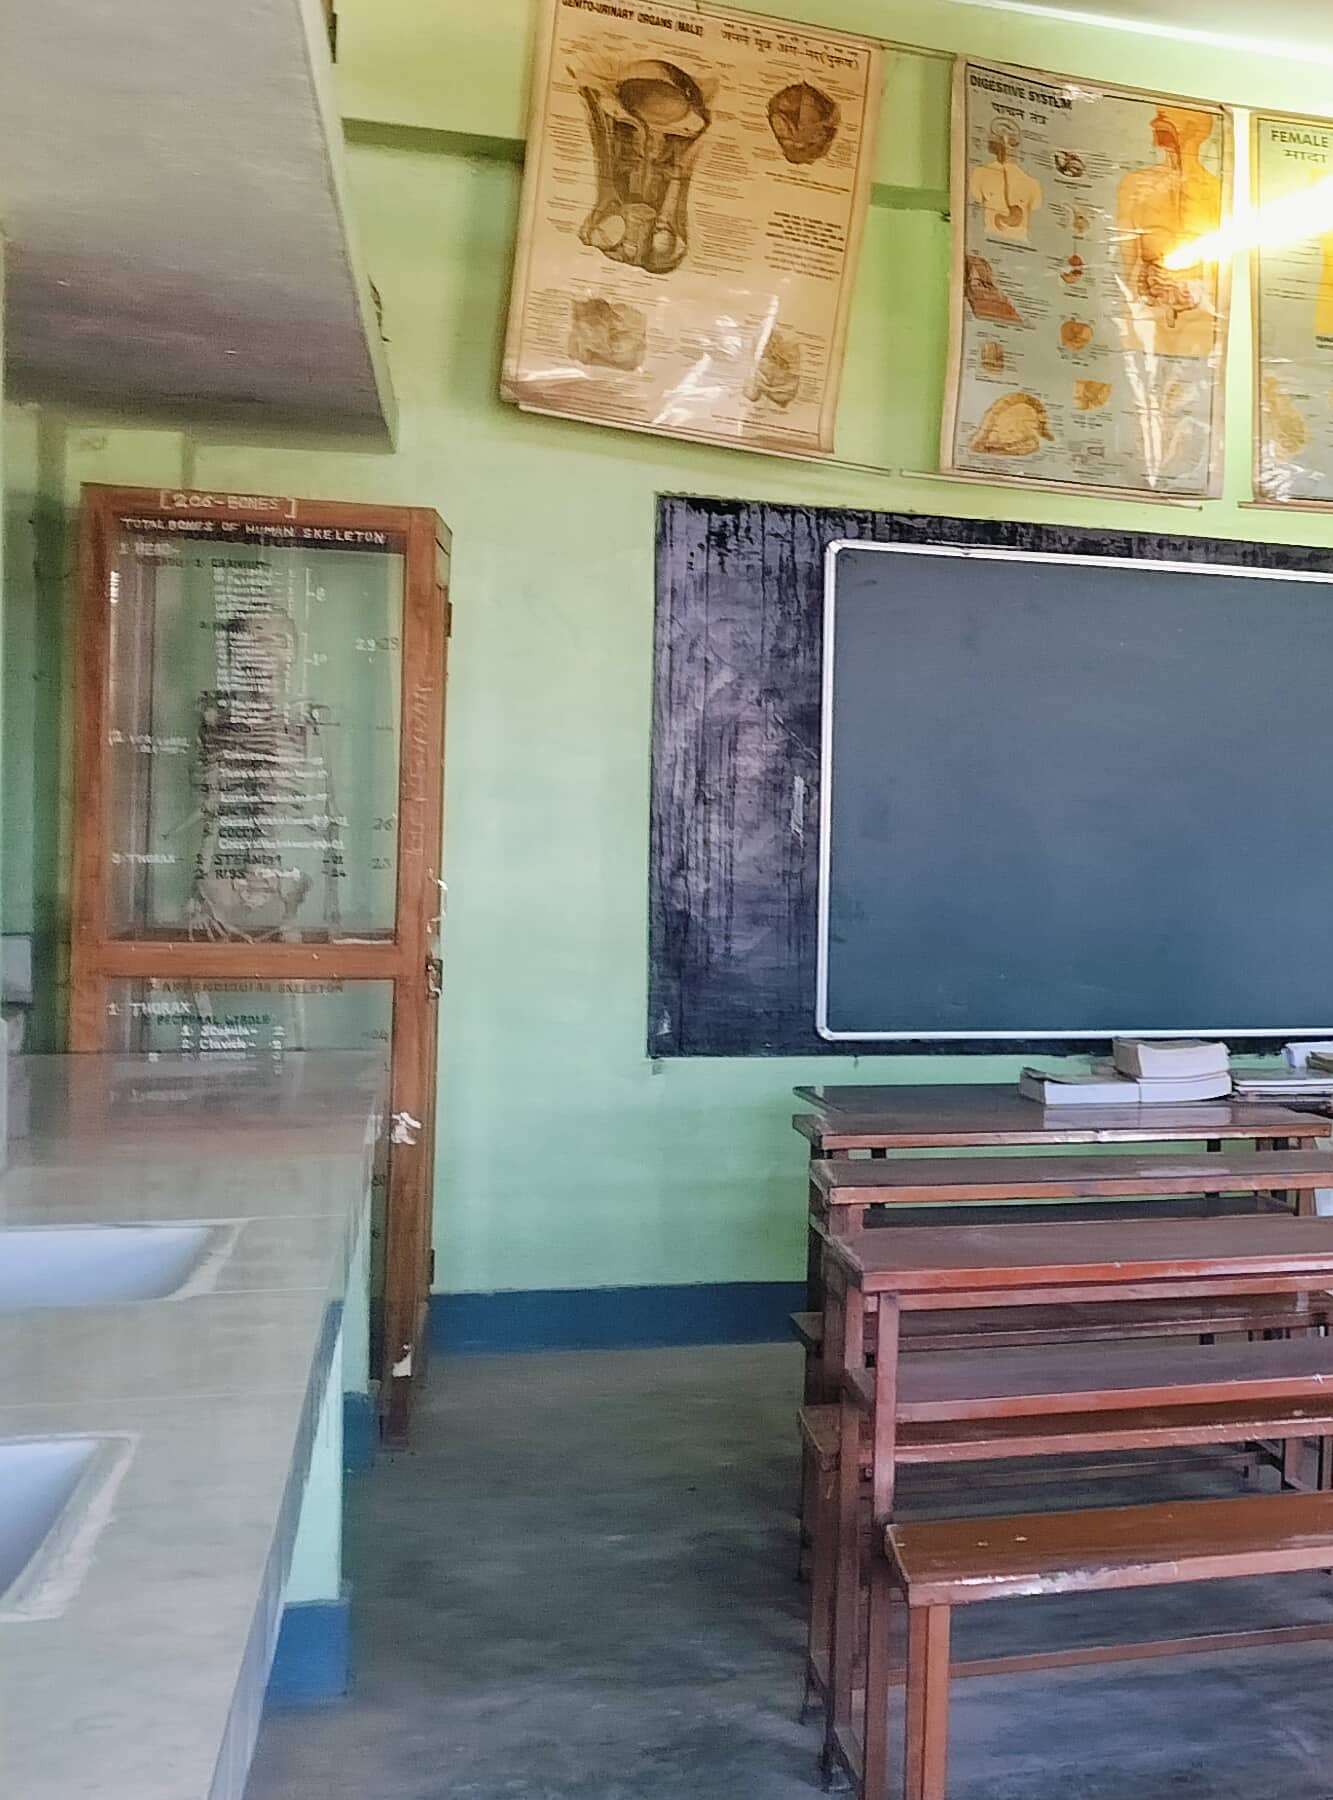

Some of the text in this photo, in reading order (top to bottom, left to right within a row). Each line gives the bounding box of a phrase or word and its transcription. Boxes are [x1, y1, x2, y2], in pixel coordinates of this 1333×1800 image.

[637, 13, 673, 29] ORGANS
[970, 74, 1073, 110] DIGESTIVE SYSTEM
[1271, 129, 1329, 149] FEMALE
[1283, 148, 1328, 165] मादा
[221, 521, 241, 532] OF
[245, 523, 295, 538] HUMAN
[303, 527, 386, 545] SKELETON
[128, 1000, 193, 1018] THORAX
